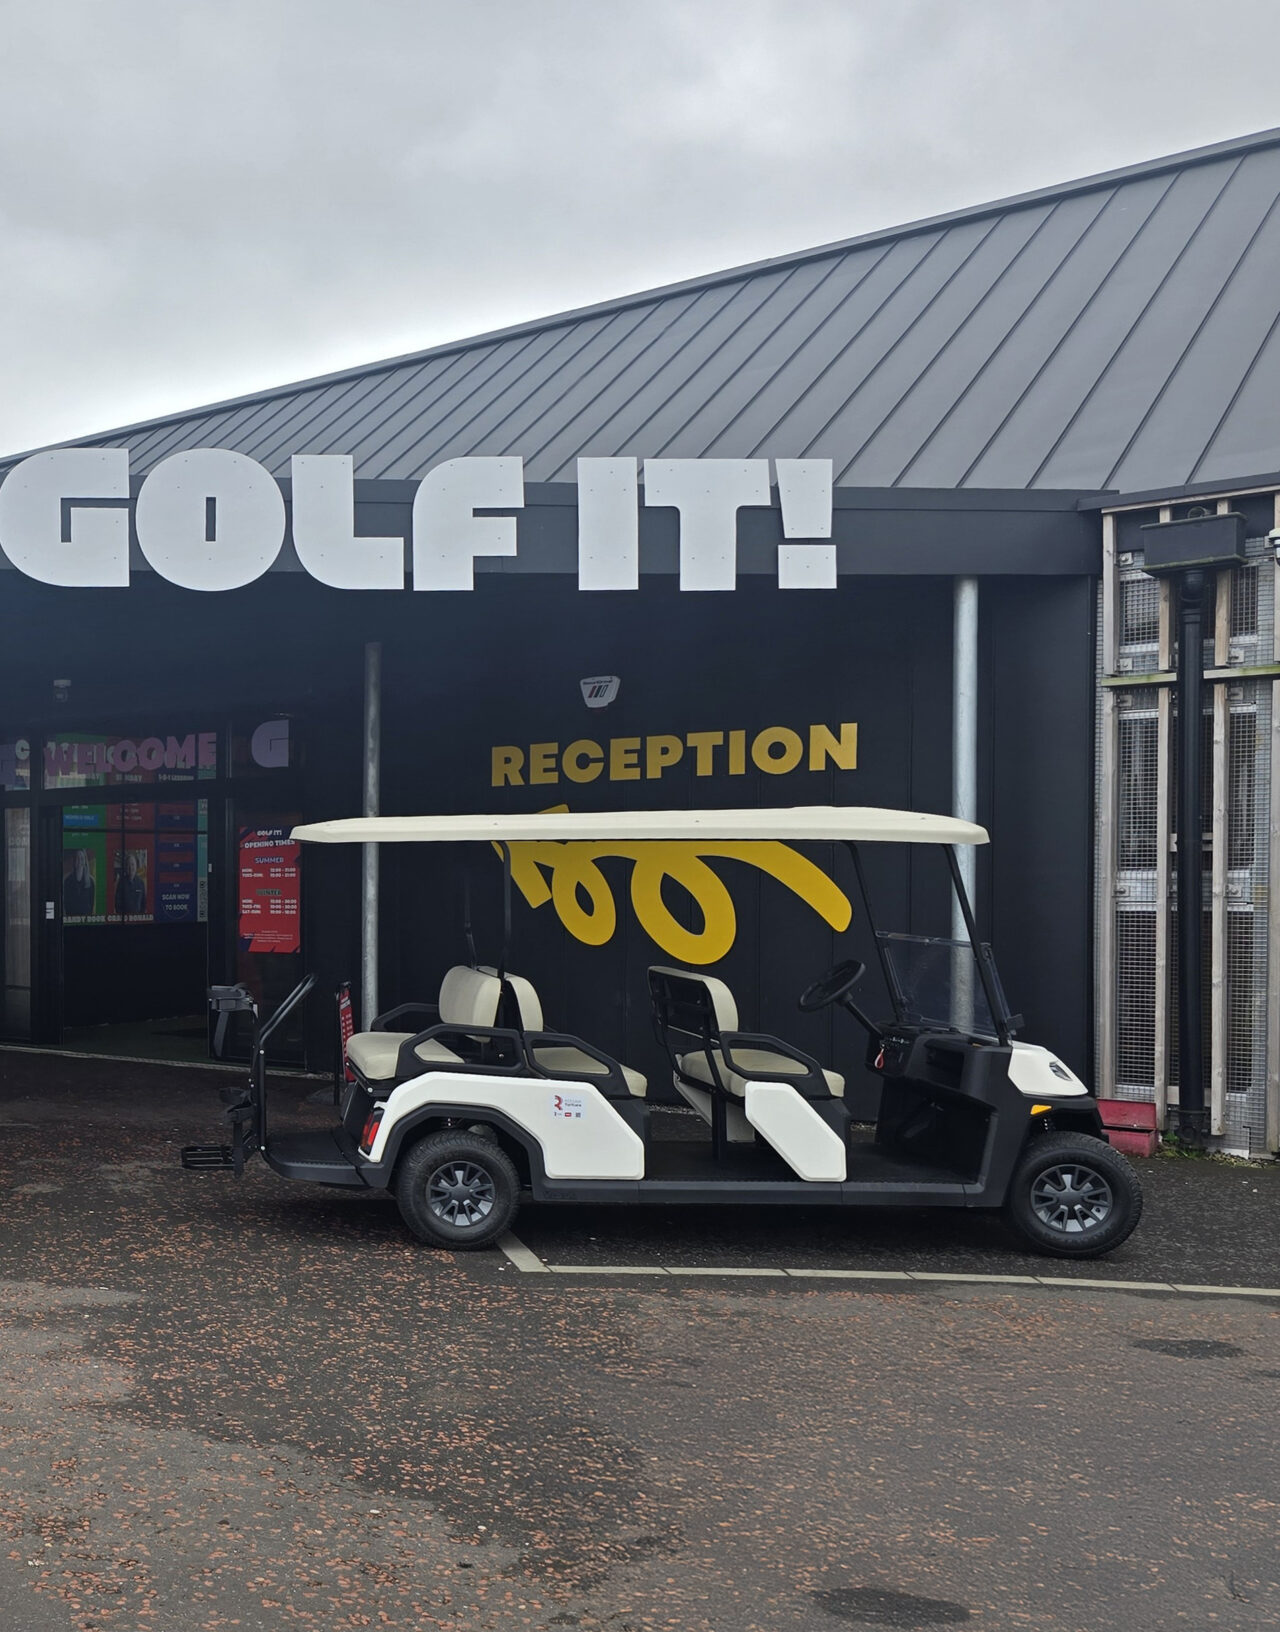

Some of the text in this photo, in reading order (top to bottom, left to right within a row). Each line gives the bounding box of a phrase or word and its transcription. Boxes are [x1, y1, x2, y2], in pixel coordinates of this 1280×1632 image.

[578, 457, 836, 590] IT!
[44, 732, 217, 776] WELCOME
[491, 722, 858, 787] RECEPTION
[244, 840, 275, 849] OPENING
